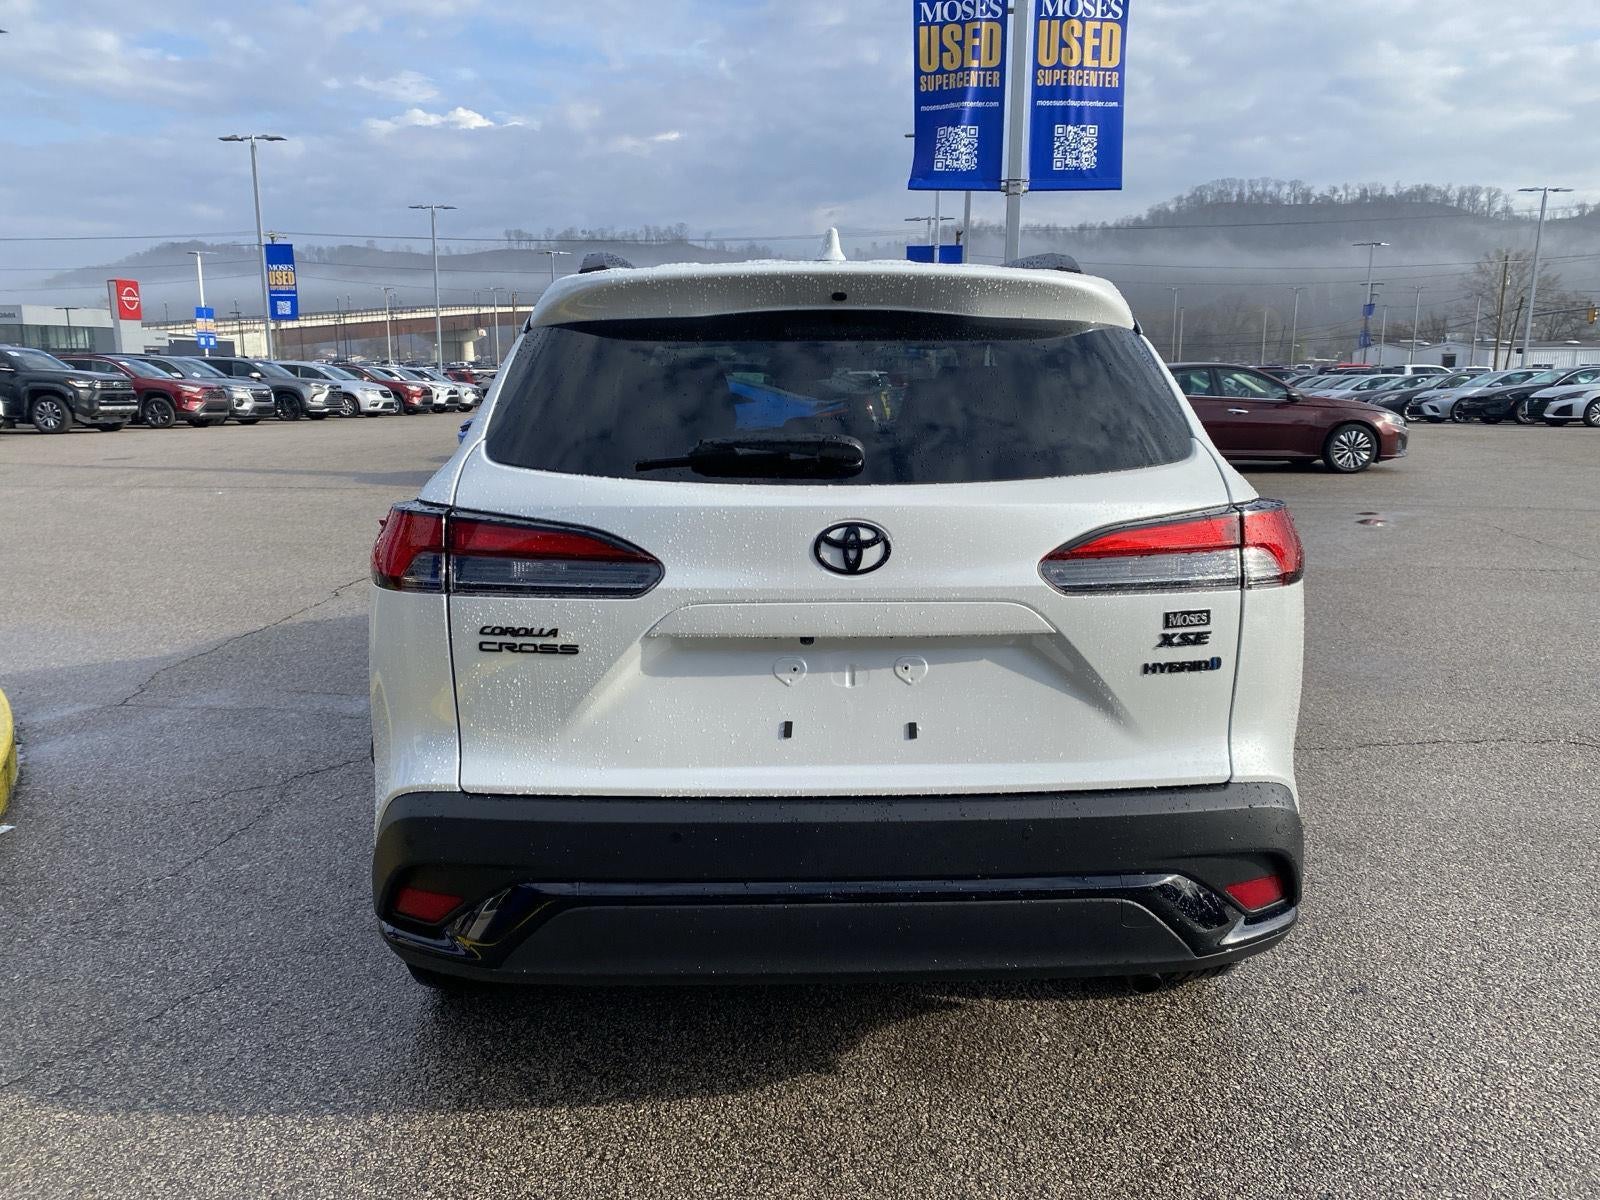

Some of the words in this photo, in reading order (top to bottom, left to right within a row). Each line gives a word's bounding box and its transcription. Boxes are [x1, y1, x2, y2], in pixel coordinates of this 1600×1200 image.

[919, 0, 1003, 23] MOSES
[1039, 0, 1123, 20] MOSES
[919, 21, 1002, 73] USED
[1037, 19, 1122, 69] USED
[919, 70, 1000, 93] SUPERCENTER
[1036, 69, 1119, 88] SUPERCENTER
[920, 100, 999, 112] mosesusedsupercenter.com
[1036, 99, 1119, 108] mosesusedsupercenter.com
[269, 271, 295, 285] USED
[479, 625, 559, 638] COROLLA
[1152, 630, 1212, 649] XSE
[478, 641, 580, 655] CROSS
[1142, 660, 1211, 675] HYBRID
